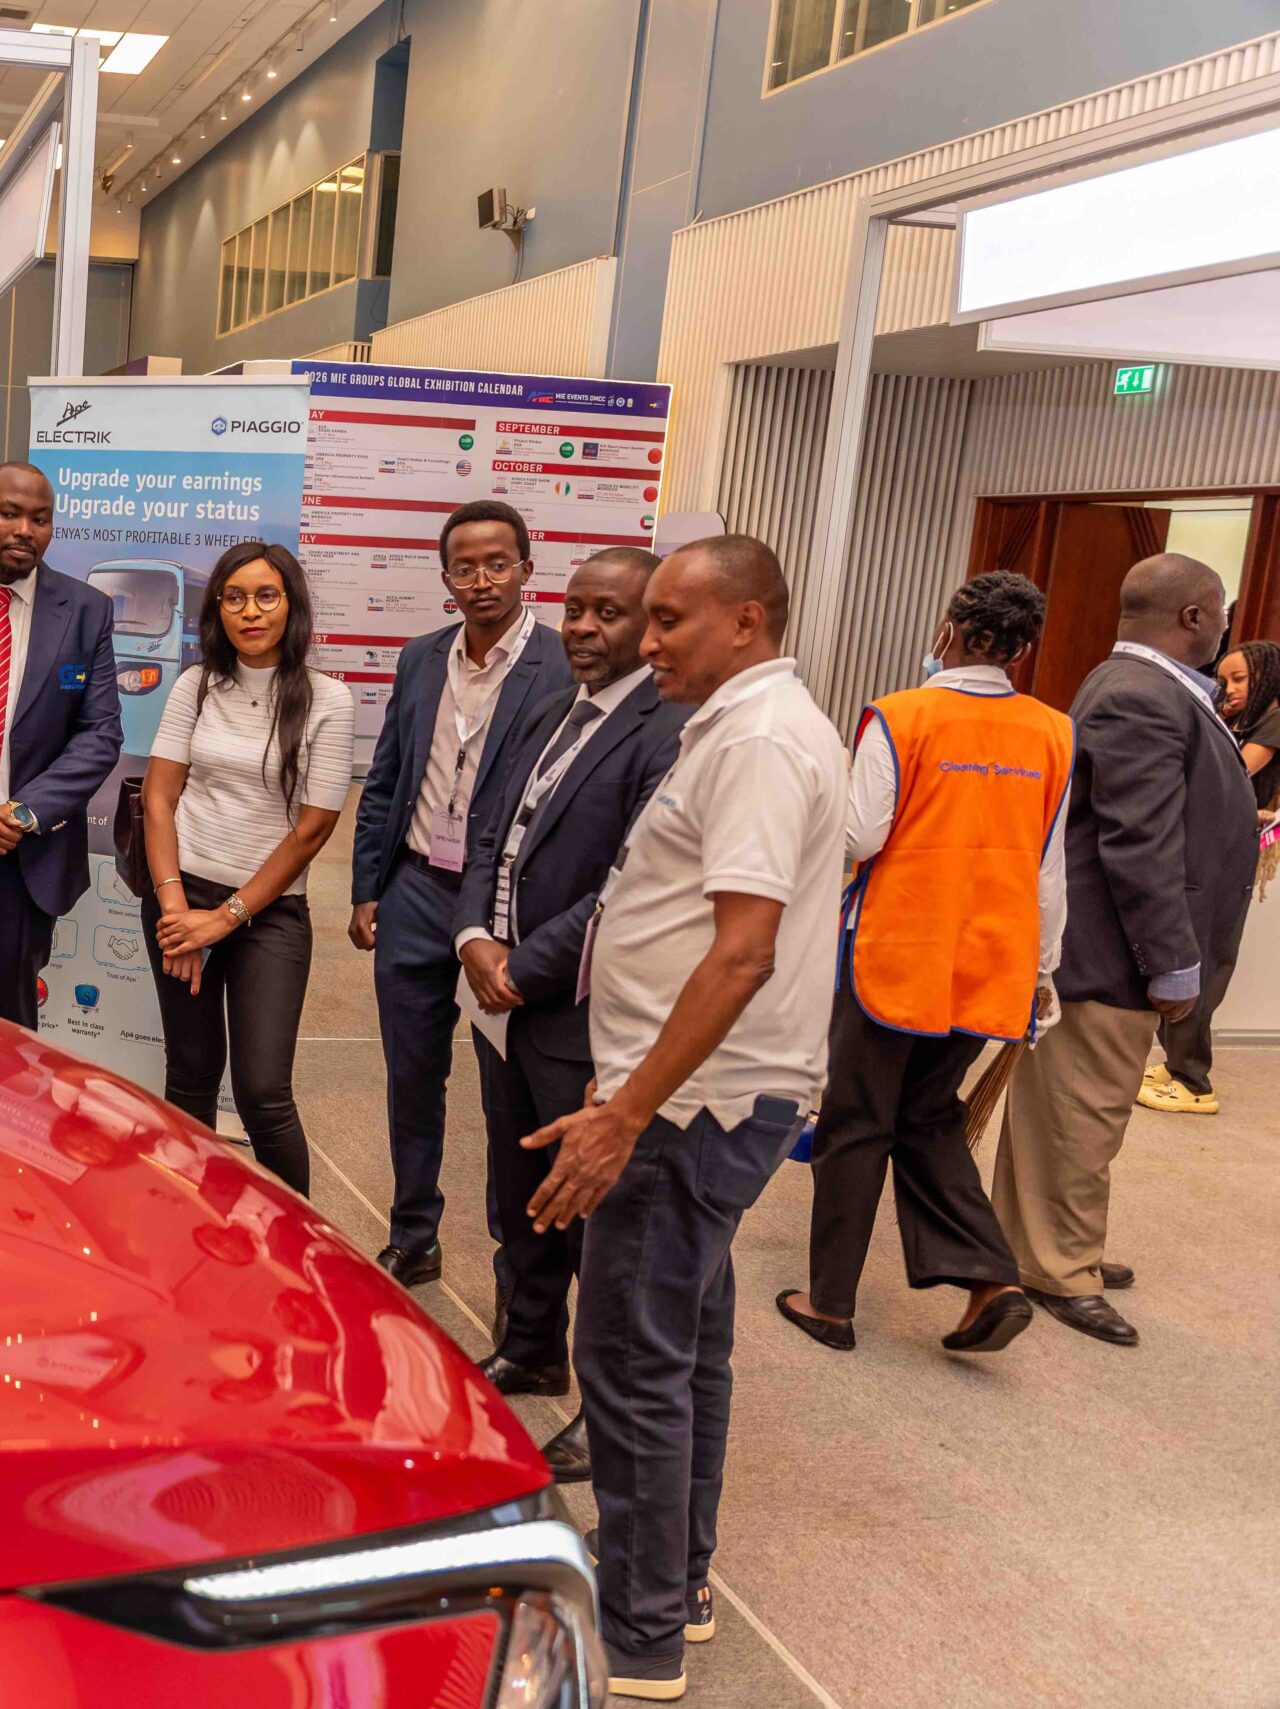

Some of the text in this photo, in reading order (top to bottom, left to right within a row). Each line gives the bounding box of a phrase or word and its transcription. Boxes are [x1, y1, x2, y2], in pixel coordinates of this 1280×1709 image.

[330, 372, 348, 385] MIE
[349, 373, 386, 387] GROUPS
[387, 376, 422, 389] GLOBAL
[424, 378, 475, 393] EXHIBITION
[477, 382, 524, 396] CALENDAR
[555, 392, 567, 400] MIE
[567, 393, 589, 401] EVENTS
[590, 395, 606, 403] DMCC
[230, 420, 301, 434] PIAGGIO
[498, 422, 560, 435] SEPTEMBER
[36, 430, 112, 444] ELECTRIK
[494, 461, 543, 473] OCTOBER
[58, 467, 263, 496] Upgrade your earnings
[56, 493, 261, 522] Upgrade your status
[52, 527, 90, 541] ENYA'S
[93, 529, 123, 542] MOST
[125, 530, 192, 546] PROFITABLE
[194, 534, 201, 546] 3
[939, 761, 1041, 779] Cleaning Services
[106, 971, 119, 980] Trust
[67, 1018, 105, 1031] Best in class
[134, 1033, 151, 1041] goes
